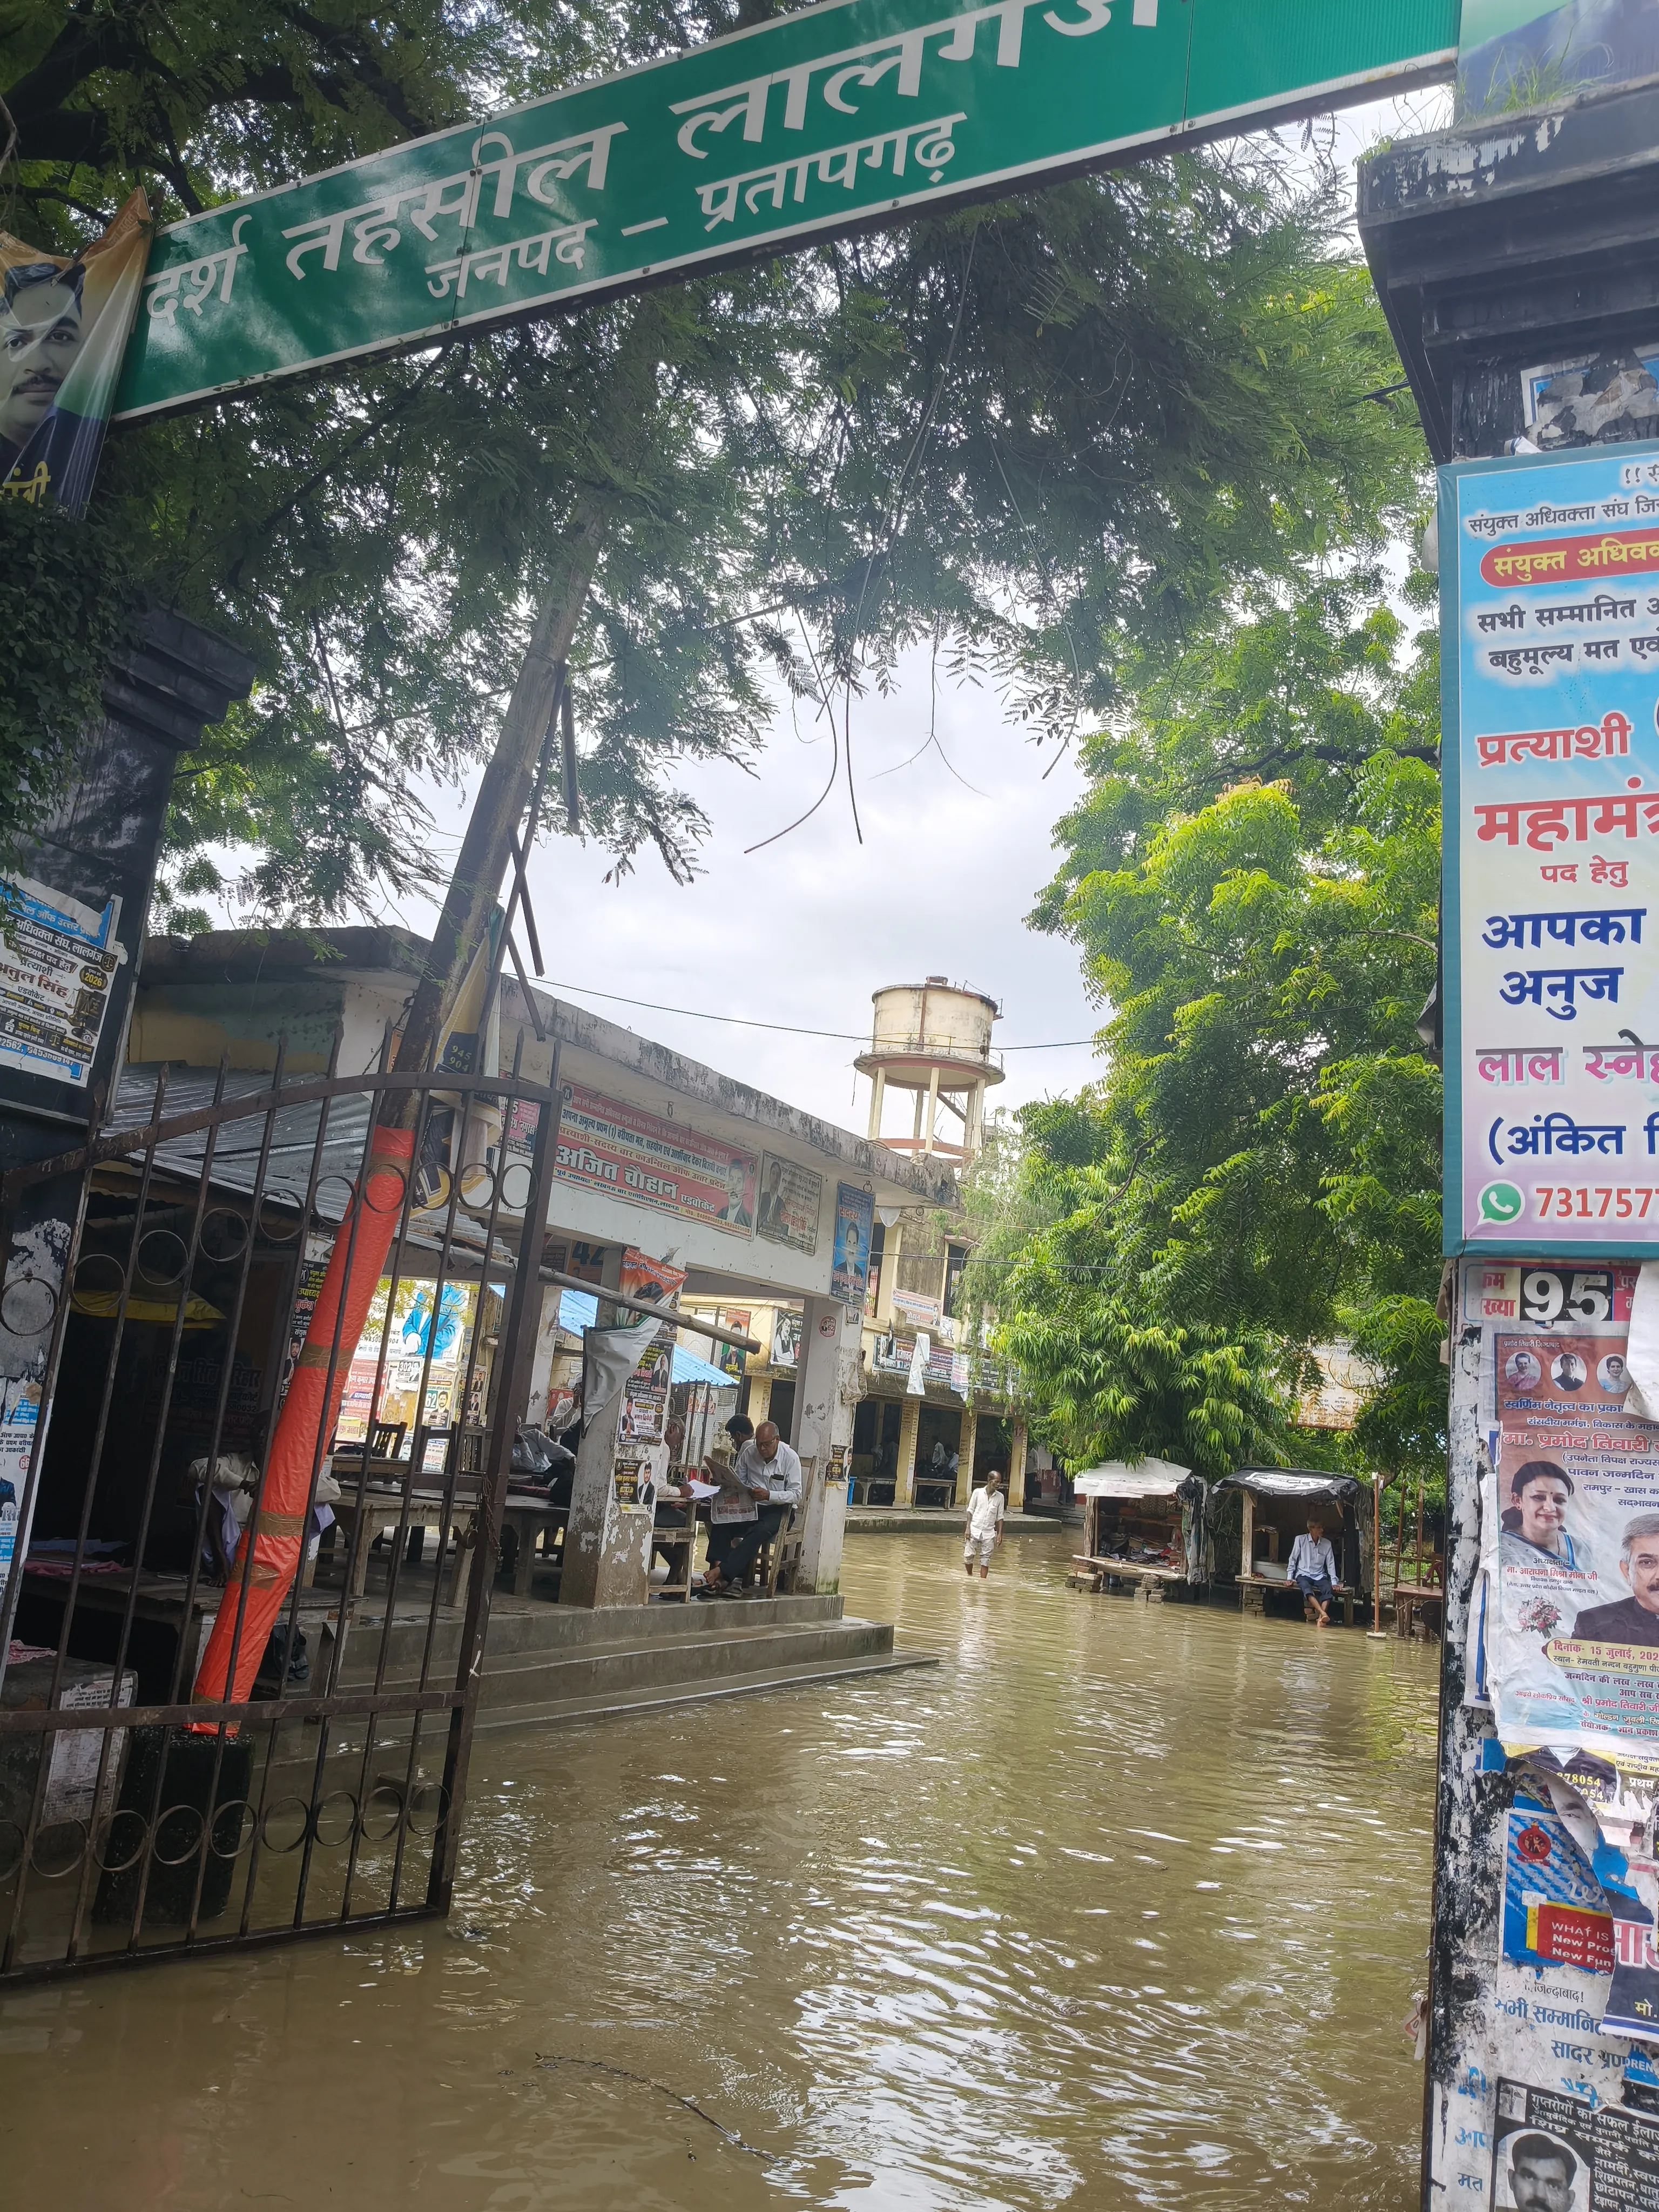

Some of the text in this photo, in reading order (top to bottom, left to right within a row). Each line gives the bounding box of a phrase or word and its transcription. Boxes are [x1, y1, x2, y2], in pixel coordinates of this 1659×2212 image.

[425, 112, 967, 298] जनपद प्रतापगढ़
[144, 214, 252, 327] दर्श
[281, 122, 629, 281] तहसील
[1469, 499, 1629, 536] संयुक्त अधिवक्ता संघ
[1494, 548, 1566, 582] संयुक्त
[1478, 595, 1636, 632] सभी सम्मानित
[1489, 640, 1620, 675] बहुमूल्य मत
[1477, 712, 1631, 766] प्रत्याशी
[1540, 855, 1629, 887] पद हेतु
[37, 909, 80, 931] ऑफ उत्तर
[1481, 908, 1647, 949] आपका
[16, 918, 53, 943] अधिवक्ता
[55, 935, 70, 951] संघ,
[72, 942, 103, 963] लालगंज
[38, 974, 69, 998] सिंह
[84, 973, 103, 986] 2026
[18, 986, 45, 1001] एडवोकेट
[1500, 967, 1624, 1021] अनुज
[0, 1037, 24, 1053] 2562,
[1475, 1047, 1563, 1082] लाल
[562, 1109, 578, 1123] अपना
[579, 1115, 596, 1131] अमूल्य
[596, 1121, 608, 1134] प्रथम
[617, 1129, 635, 1143] वरीयता
[1489, 1112, 1626, 1165] (अंकित
[556, 1144, 620, 1181] अजित
[624, 1161, 679, 1201] चौहान
[680, 1193, 716, 1213] एडवोकेट
[1536, 1188, 1659, 1217] 731757
[1523, 1272, 1609, 1321] 95
[1504, 1339, 1517, 1347] प्रमोद
[1503, 1397, 1623, 1414] स्वर्णिम नेतृत्व का प्रका
[1527, 1417, 1560, 1426] संसदीय
[1593, 1419, 1623, 1429] विकास
[1626, 1421, 1635, 1429] के
[1502, 1431, 1650, 1452] मा. प्रमोद तिवारी
[1562, 1452, 1627, 1464] (उपनेता विपक्ष
[1567, 1467, 1655, 1480] पावन जन्मदिन
[1583, 1484, 1647, 1495] रामपुर खास
[1533, 1557, 1563, 1566] अध्यक्षता
[1520, 1567, 1548, 1576] आराधना
[1550, 1568, 1567, 1578] मिश्रा
[1569, 1569, 1585, 1579] मोना
[1587, 1571, 1597, 1580] जी
[1577, 1656, 1600, 1667] हेमवती
[1602, 1661, 1620, 1669] नन्दन
[1590, 1646, 1602, 1655] 15
[1606, 1646, 1635, 1660] जुलाई,
[1640, 1651, 1659, 1661] 202
[1564, 1672, 1596, 1682] जन्मदिन
[1599, 1674, 1610, 1683] की
[1613, 1677, 1630, 1686] लख
[1533, 1692, 1557, 1700] लोकप्रिय
[1581, 1695, 1593, 1706] श्री
[1595, 1697, 1618, 1708] प्रमोद
[1620, 1700, 1646, 1711] तिवारी
[1619, 1688, 1636, 1697] आप
[1594, 1711, 1619, 1721] गोल्डन
[1635, 1727, 1658, 1737] प्रकाश
[1627, 1762, 1647, 1771] राष्ट्रीय
[1628, 1777, 1654, 1789] प्रथम
[1553, 1934, 1615, 1956] New Prog
[1596, 1932, 1609, 1940] IS
[1552, 1947, 1583, 1960] New
[1634, 1998, 1658, 2018] मो.
[1551, 2039, 1595, 2065] सादर
[1531, 2093, 1629, 2132] गुप्तरोगों का सफल
[1579, 2122, 1593, 2130] एवं
[1595, 2146, 1612, 2158] जैसे
[1458, 2172, 1483, 2191] मत
